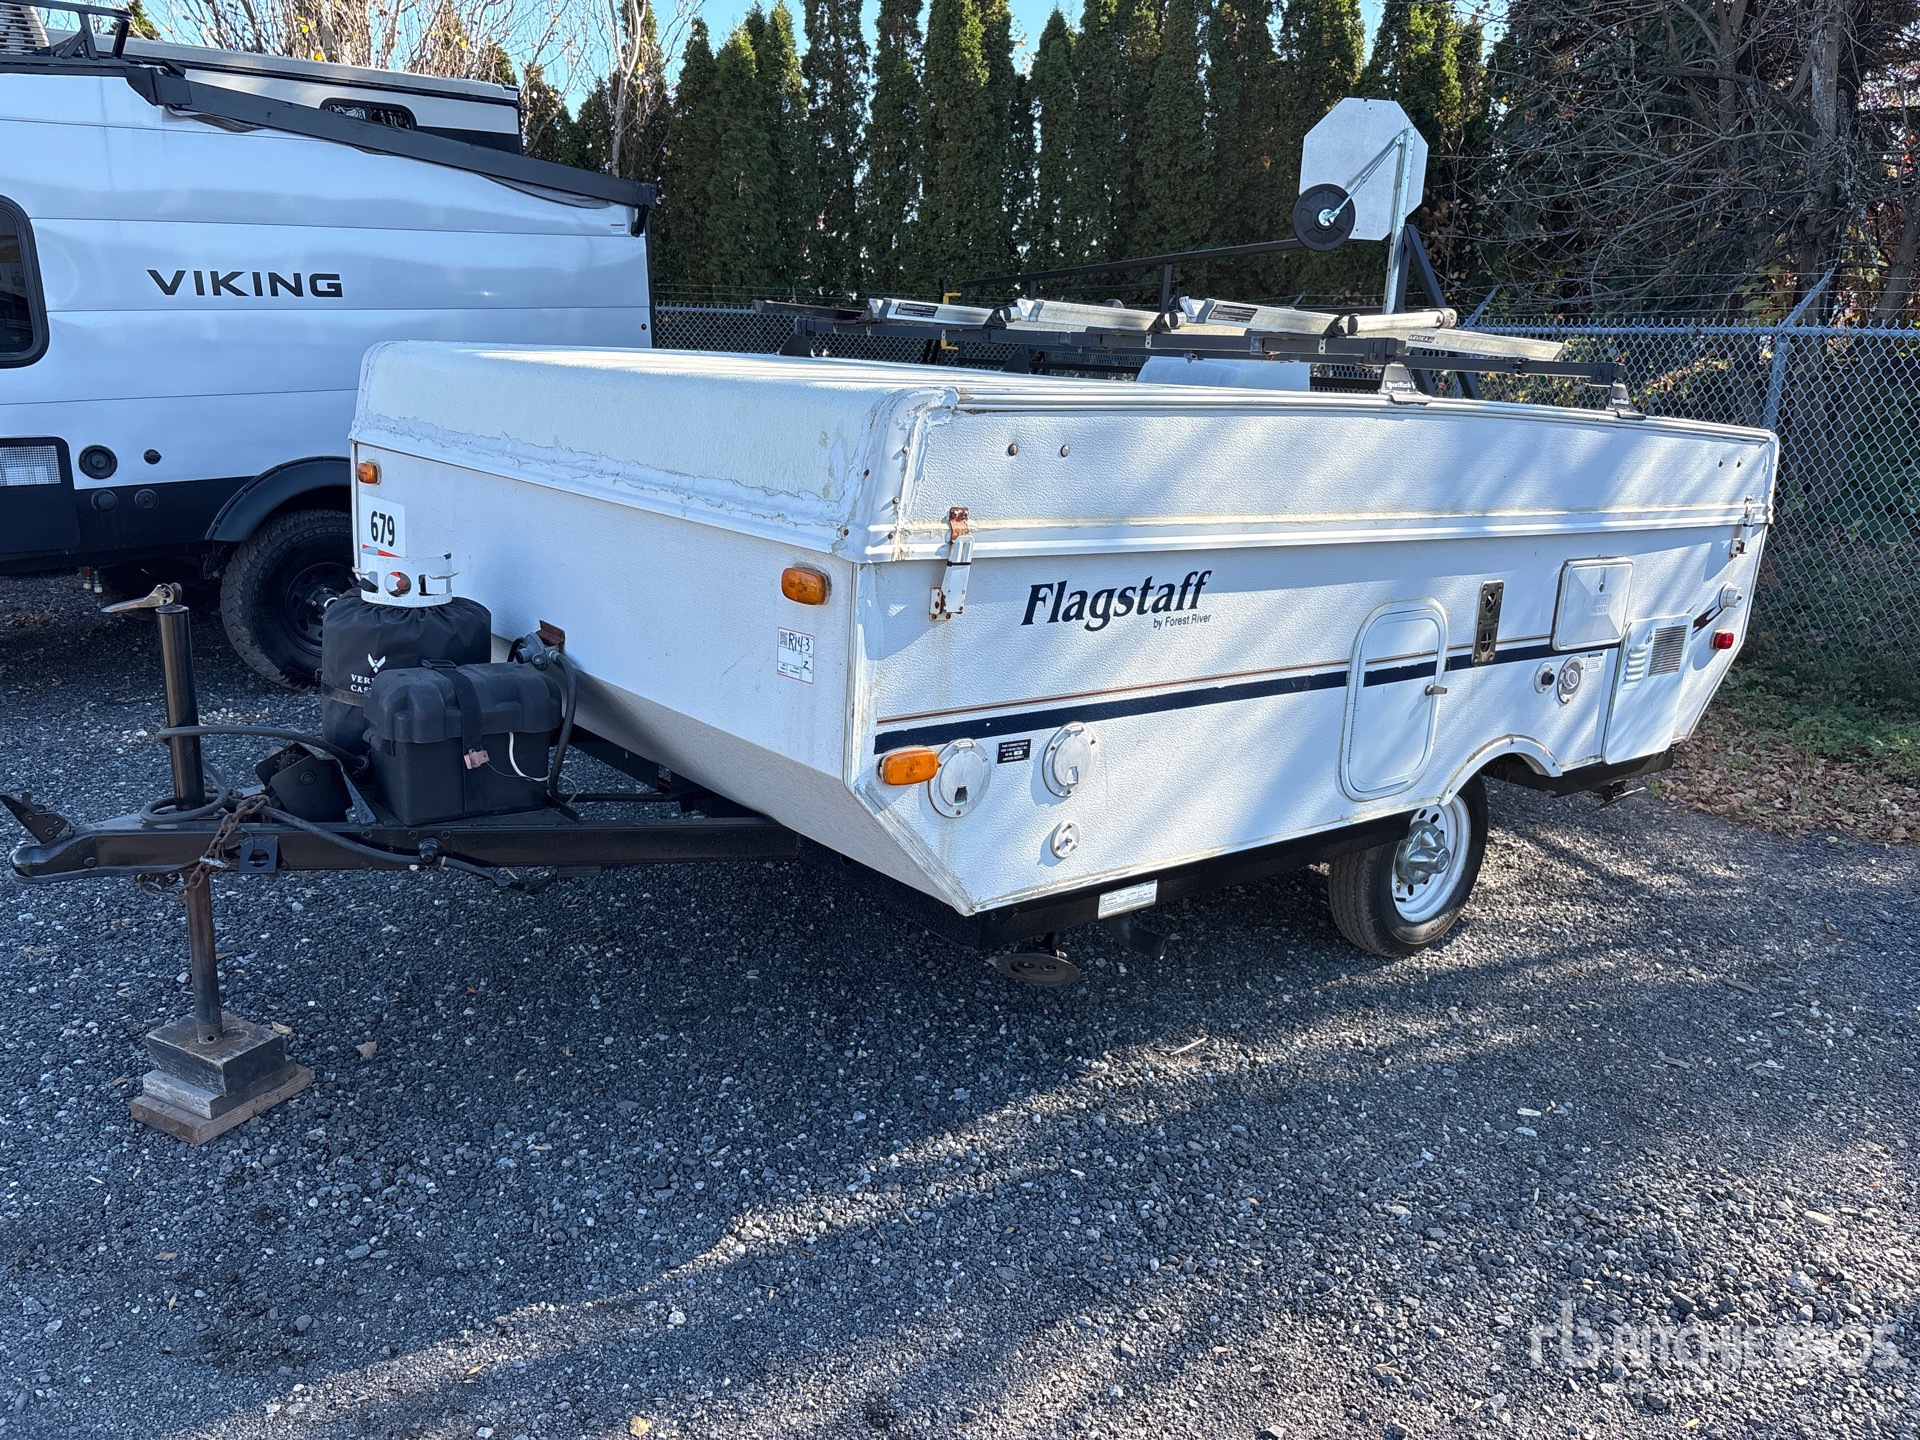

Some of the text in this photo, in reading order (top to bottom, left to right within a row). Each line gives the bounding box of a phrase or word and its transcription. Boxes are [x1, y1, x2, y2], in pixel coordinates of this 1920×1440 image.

[146, 269, 344, 298] VIKING
[371, 511, 395, 547] 679
[1020, 569, 1213, 632] Flagstaff
[1153, 613, 1212, 630] by Forest River
[350, 673, 375, 684] VER
